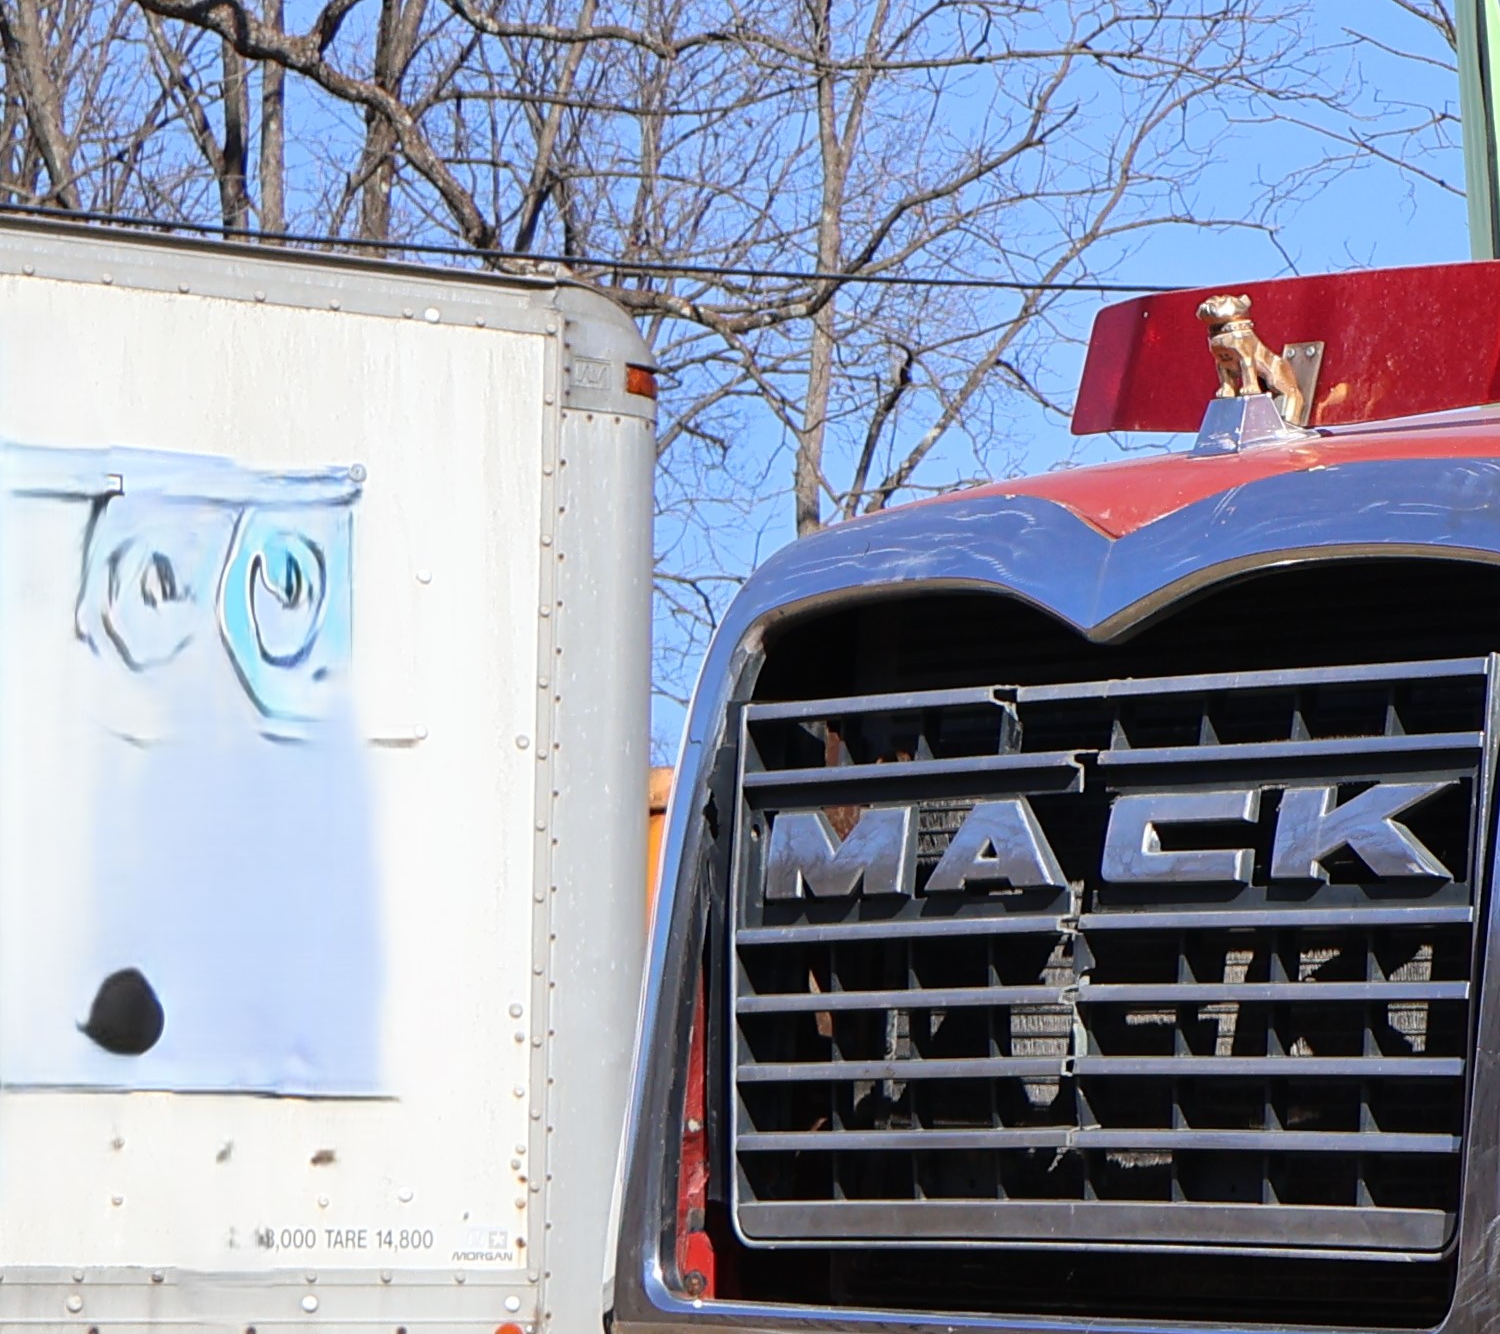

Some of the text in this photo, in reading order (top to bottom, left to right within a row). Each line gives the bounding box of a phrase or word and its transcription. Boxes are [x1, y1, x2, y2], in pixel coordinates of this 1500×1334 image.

[764, 779, 1456, 901] MACK
[324, 1229, 368, 1250] TARE
[376, 1229, 434, 1252] 14,800
[451, 1250, 513, 1262] MORGAN
